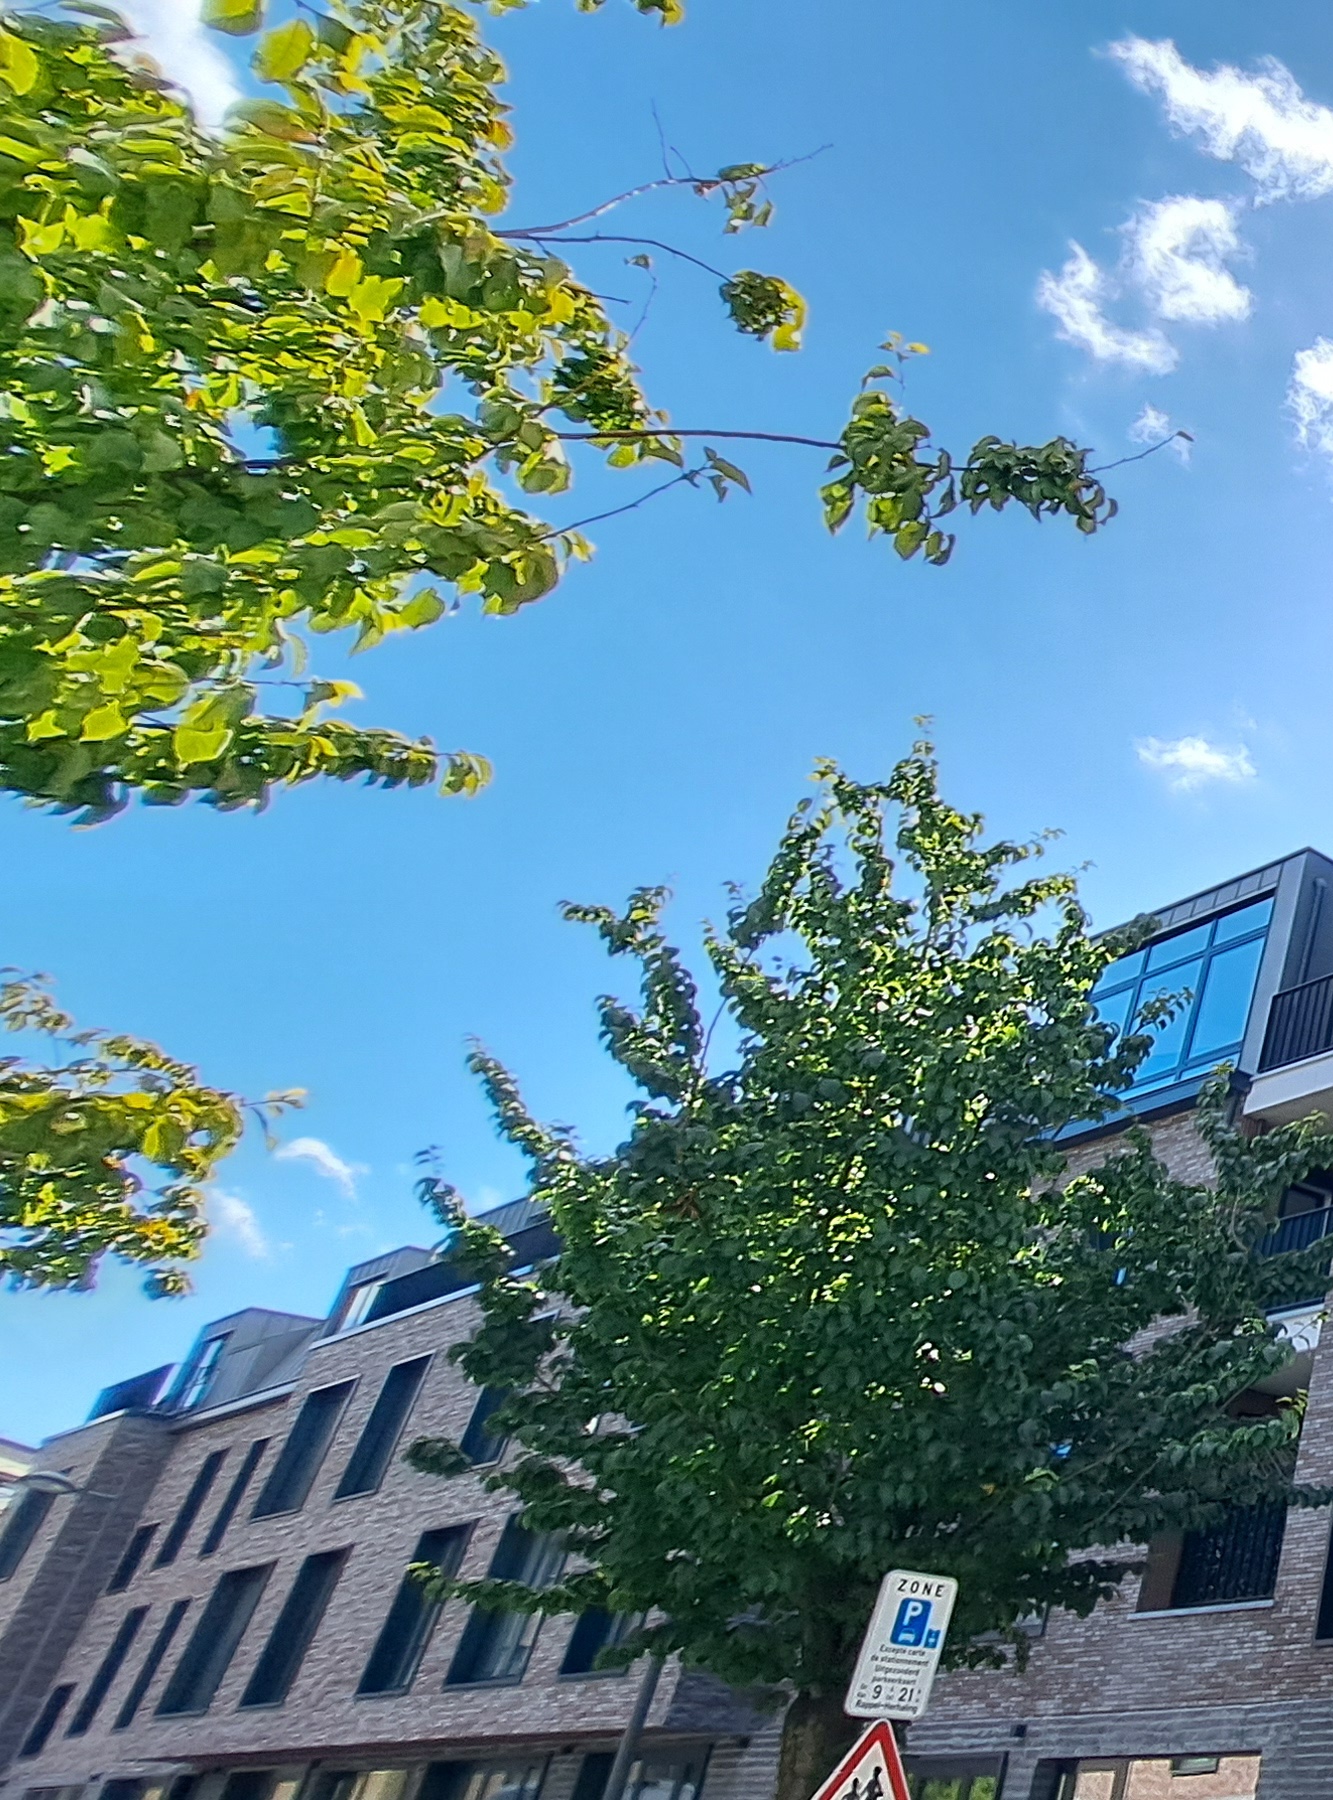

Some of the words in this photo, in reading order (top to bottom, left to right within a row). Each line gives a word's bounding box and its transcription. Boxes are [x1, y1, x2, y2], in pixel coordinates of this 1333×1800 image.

[897, 1578, 945, 1598] ZONE
[902, 1601, 923, 1626] P
[872, 1684, 883, 1700] 9
[898, 1687, 914, 1702] 21
